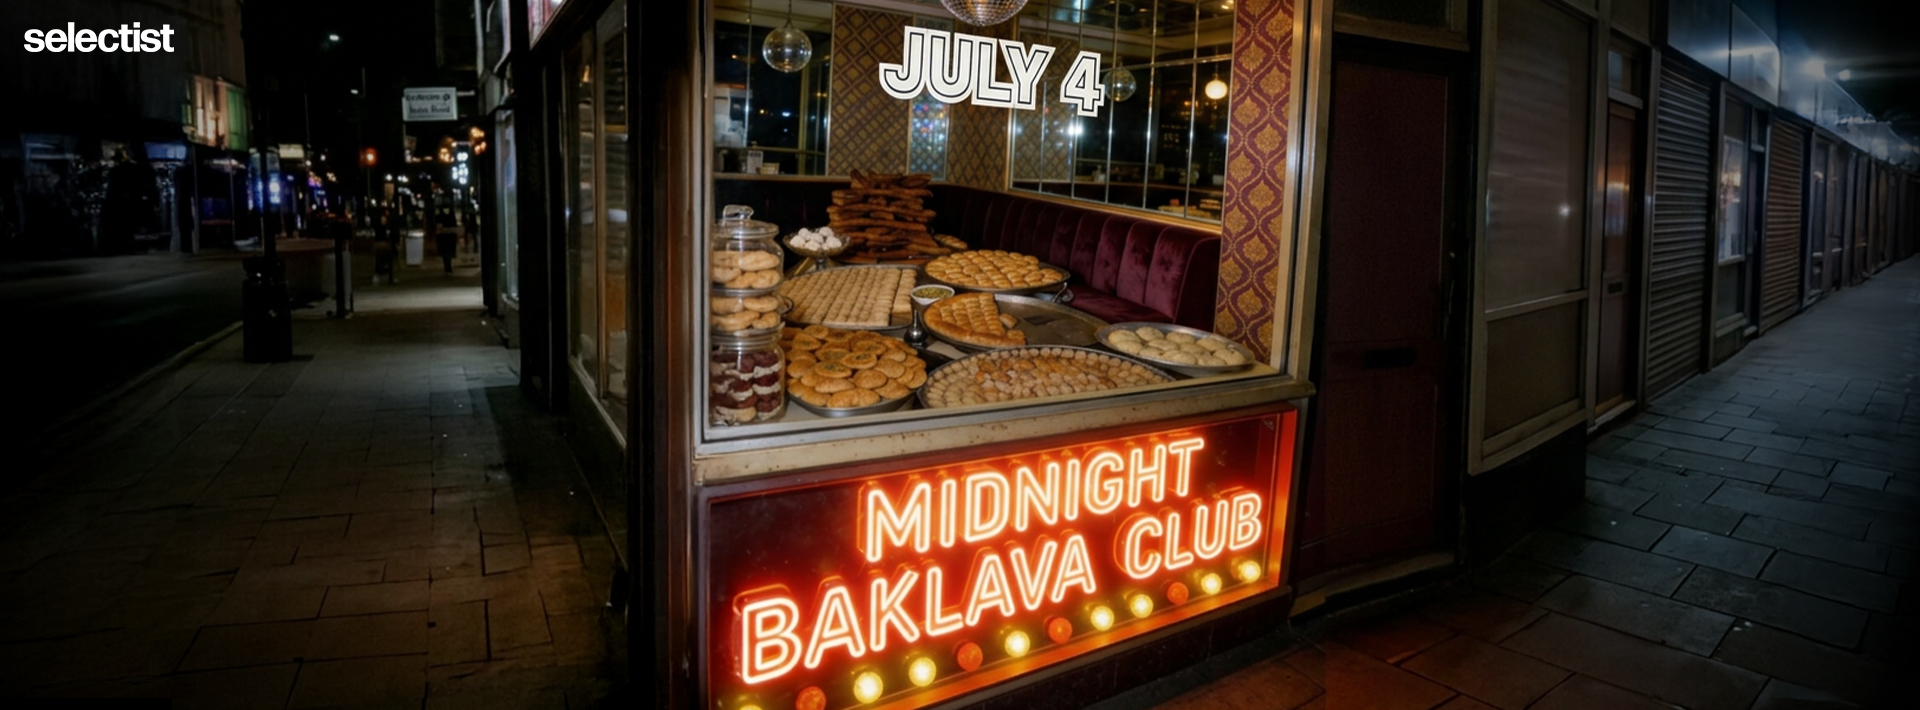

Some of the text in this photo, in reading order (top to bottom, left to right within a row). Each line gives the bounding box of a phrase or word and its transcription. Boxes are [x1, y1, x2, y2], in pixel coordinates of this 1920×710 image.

[879, 25, 1105, 117] JULY 4
[865, 437, 1204, 563] MIDNIGHT
[740, 492, 1263, 686] BAKLAVA CLUB
